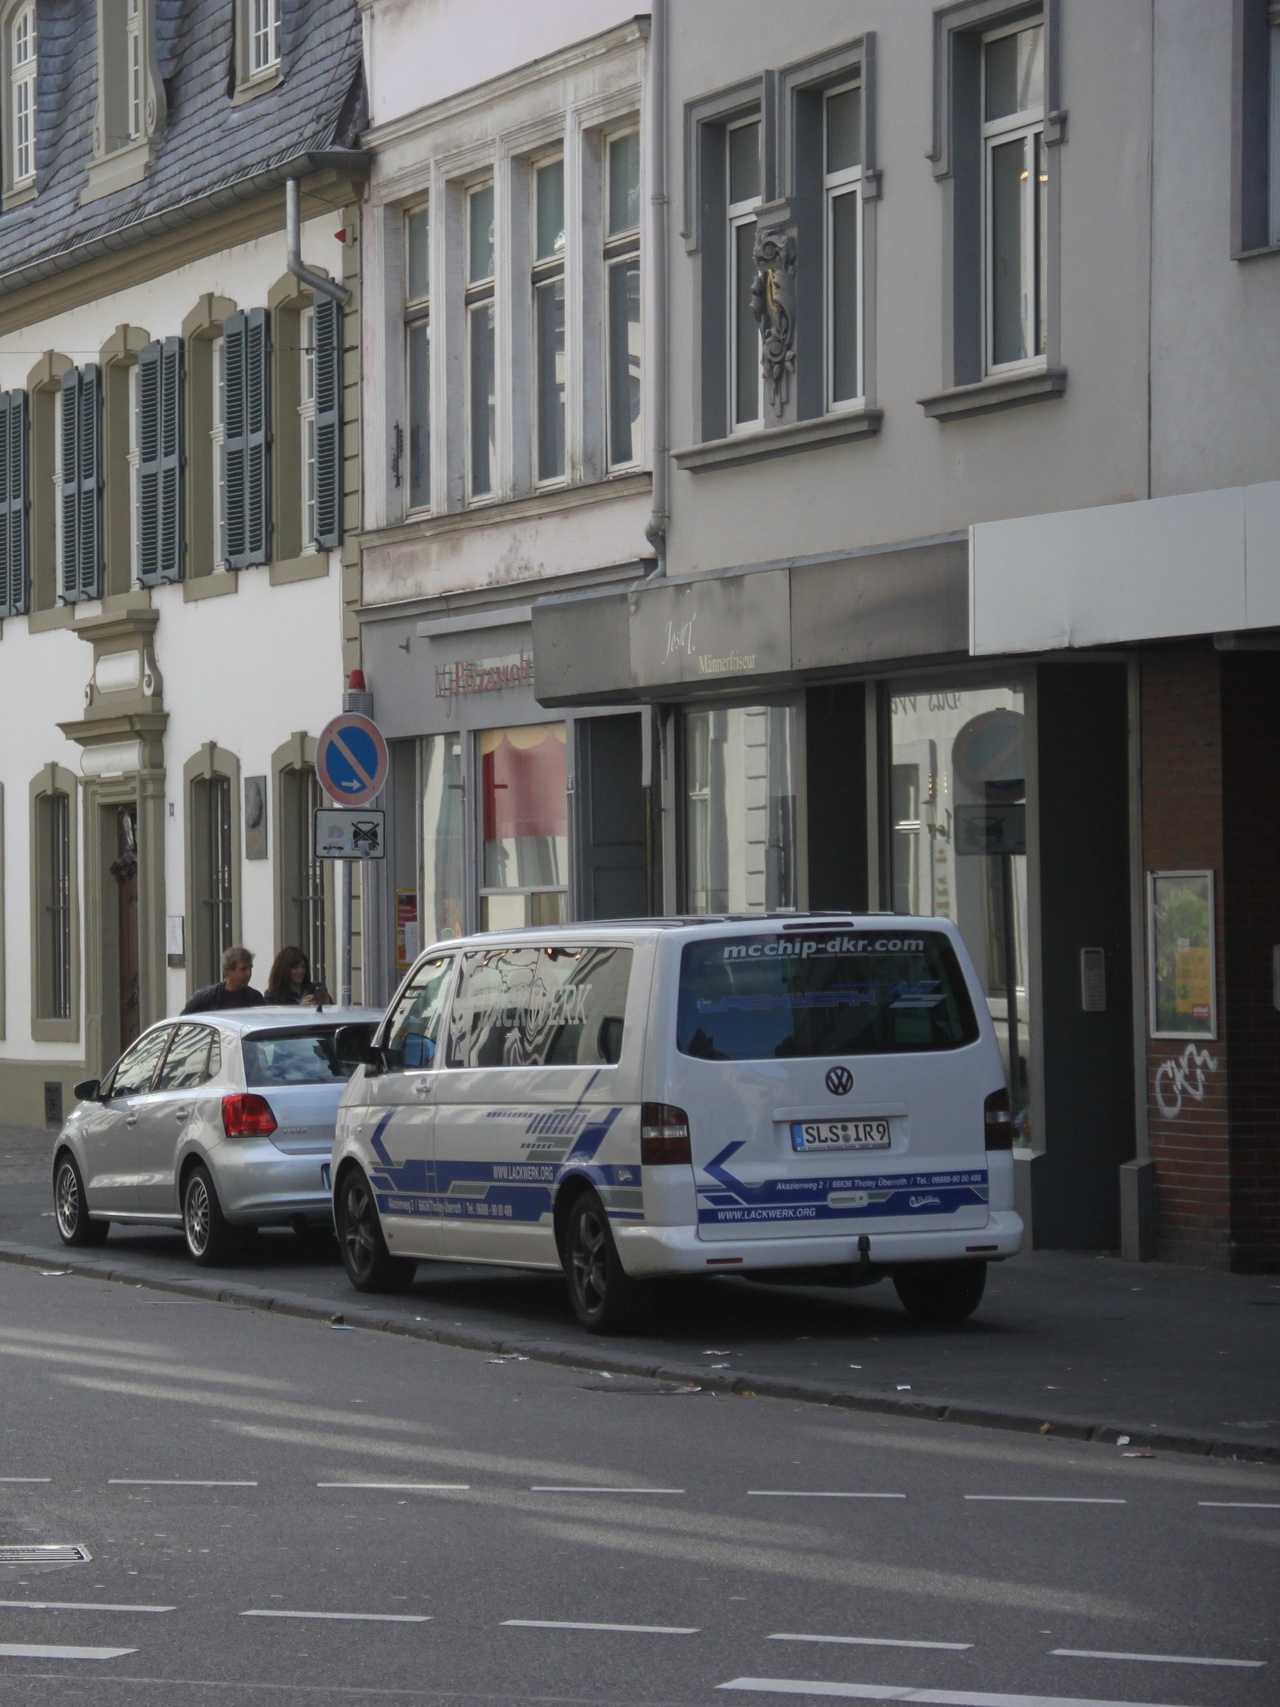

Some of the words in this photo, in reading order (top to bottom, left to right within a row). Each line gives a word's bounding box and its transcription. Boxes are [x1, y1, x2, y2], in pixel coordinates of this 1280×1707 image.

[699, 650, 757, 674] Männerfriseur
[723, 937, 925, 959] mcchip-dkr.com
[805, 1125, 840, 1144] SLS
[493, 1165, 554, 1180] WWW.LACKWERK.ORG
[776, 1182, 817, 1190] Akazienweg
[854, 1179, 876, 1189] Tholey
[878, 1177, 907, 1187] Überroth
[717, 1208, 816, 1220] WWW.LACKWERK.ORG
